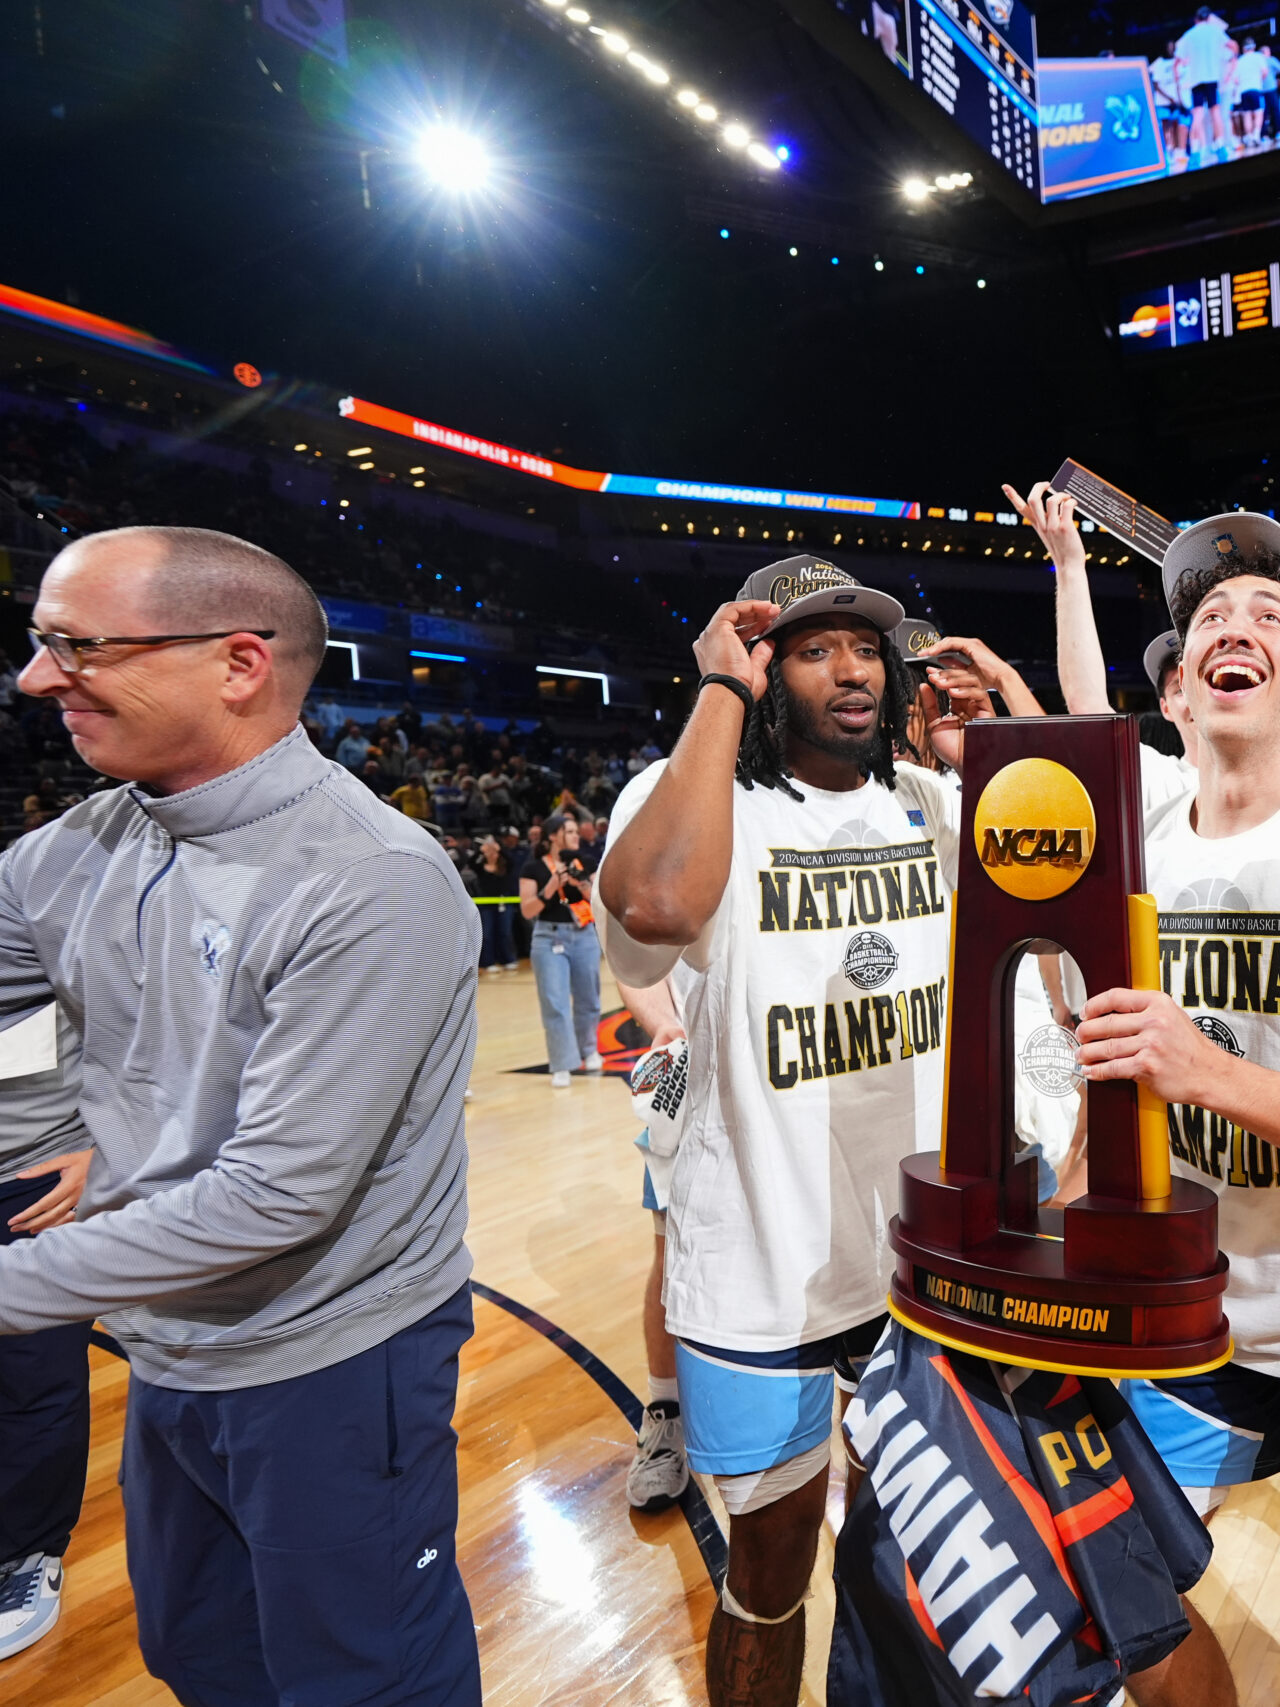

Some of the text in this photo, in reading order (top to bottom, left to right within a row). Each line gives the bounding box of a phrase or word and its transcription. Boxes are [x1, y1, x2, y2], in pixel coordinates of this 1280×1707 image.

[413, 420, 509, 464] INDIANAPOLIS
[655, 481, 782, 505] CHAMPIONS
[785, 494, 824, 508] WIN
[800, 566, 855, 587] National
[982, 827, 1089, 866] NCAA
[800, 855, 825, 866] NCAA
[864, 850, 889, 862] MEN'S
[1169, 917, 1203, 930] DIVISION
[1204, 917, 1214, 930] III
[1217, 917, 1246, 930] MEN'S
[847, 957, 894, 971] CHAMPIONSHIP
[850, 948, 889, 962] BASKETBALL
[926, 1274, 1109, 1333] NATIONAL CHAMPION
